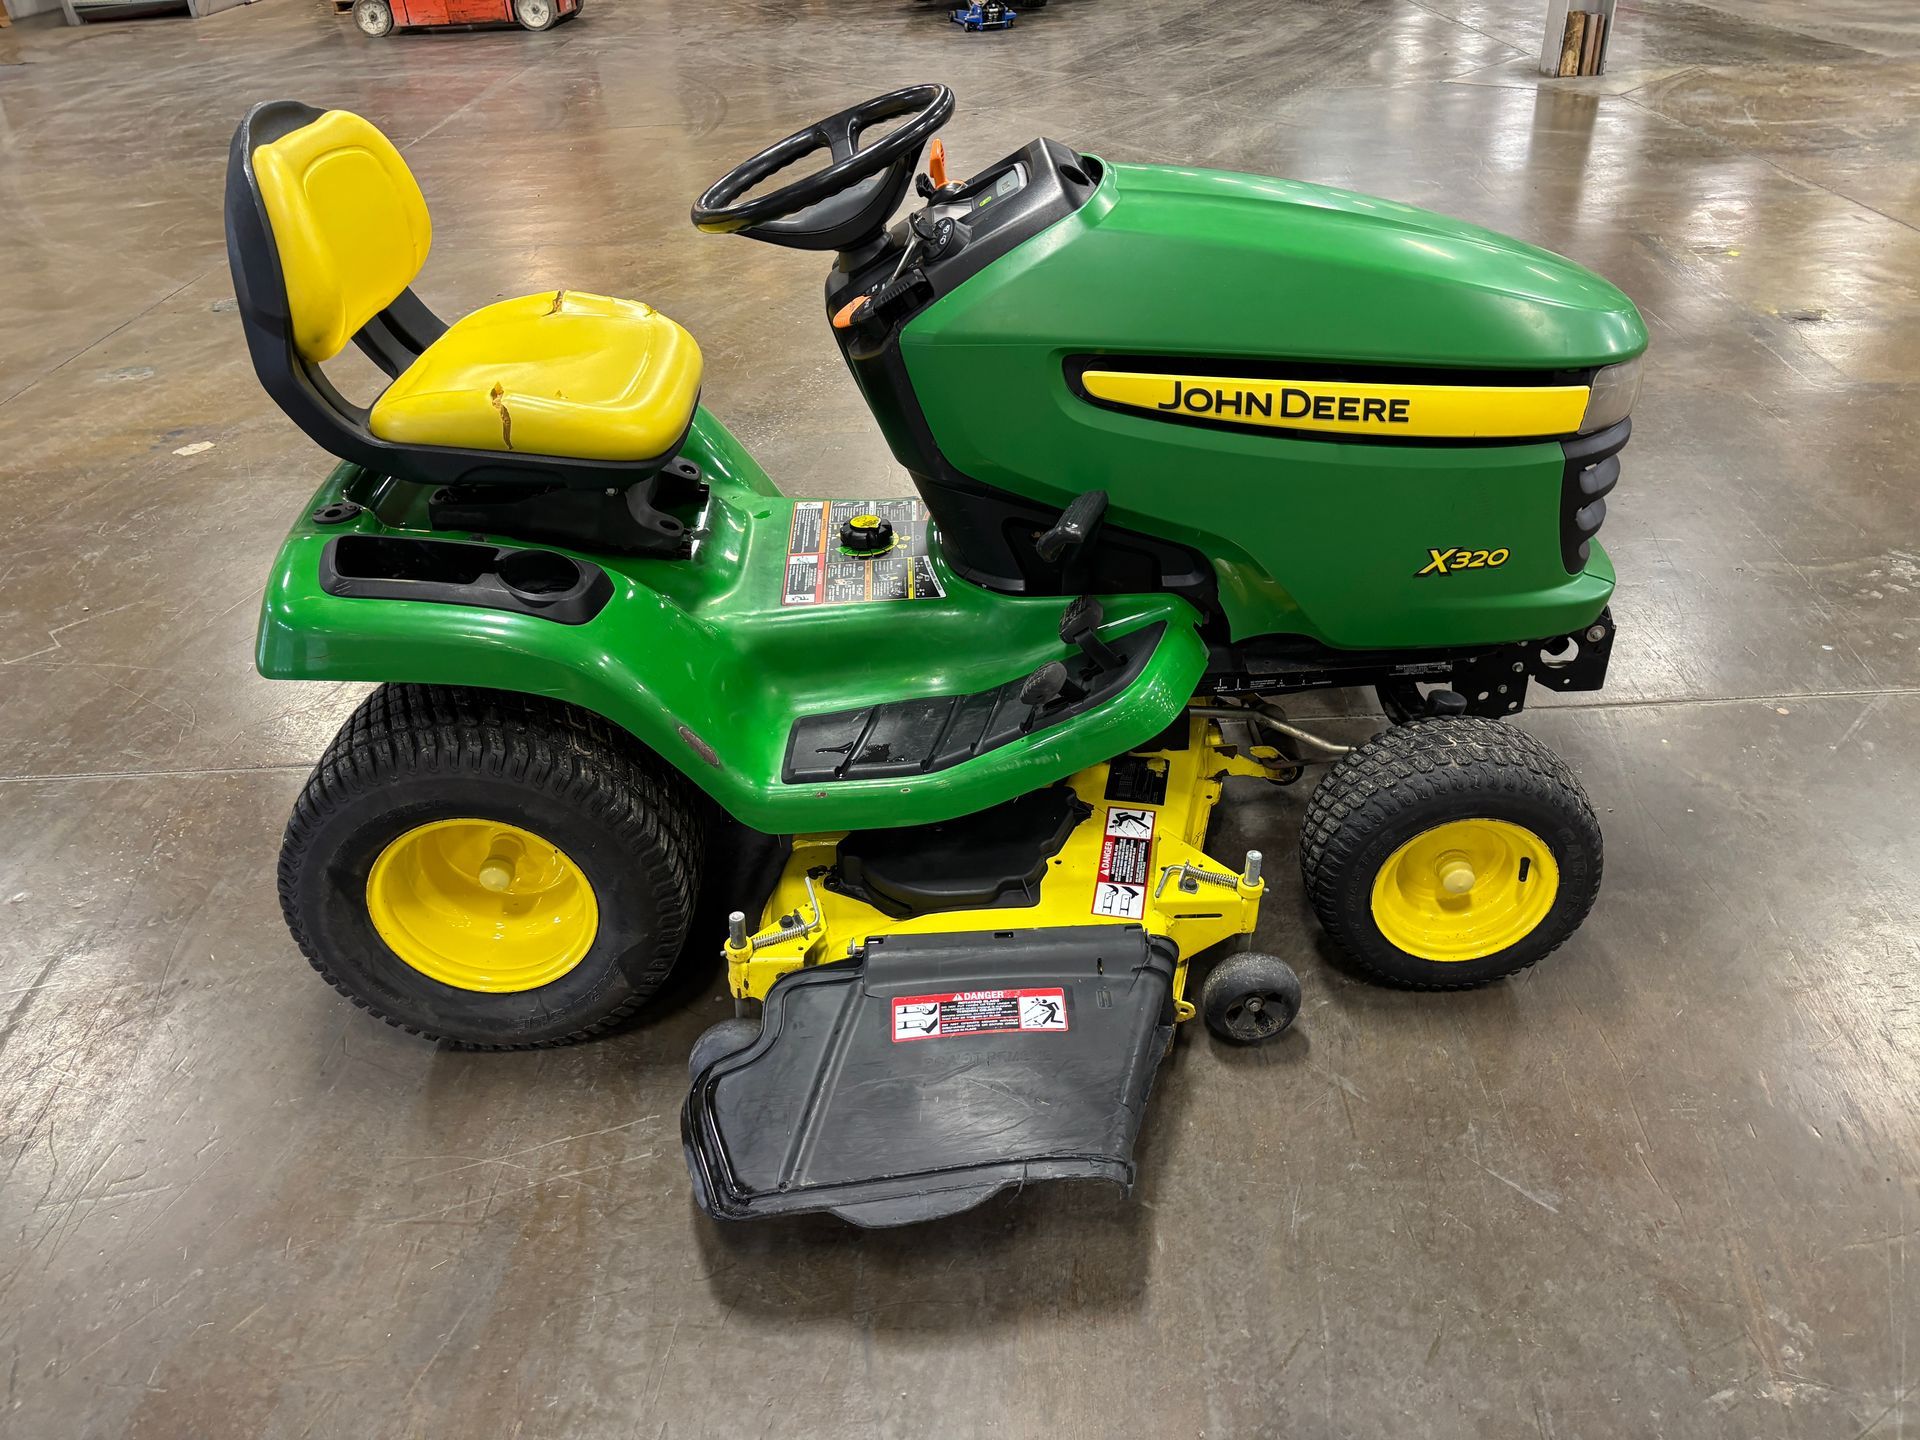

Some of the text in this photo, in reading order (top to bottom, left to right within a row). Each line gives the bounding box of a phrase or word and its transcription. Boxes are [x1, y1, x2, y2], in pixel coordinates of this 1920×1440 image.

[1158, 381, 1410, 423] JOHN DEERE
[1415, 547, 1510, 576] X320
[1101, 841, 1113, 869] DANGER
[964, 990, 1004, 1001] DANGER
